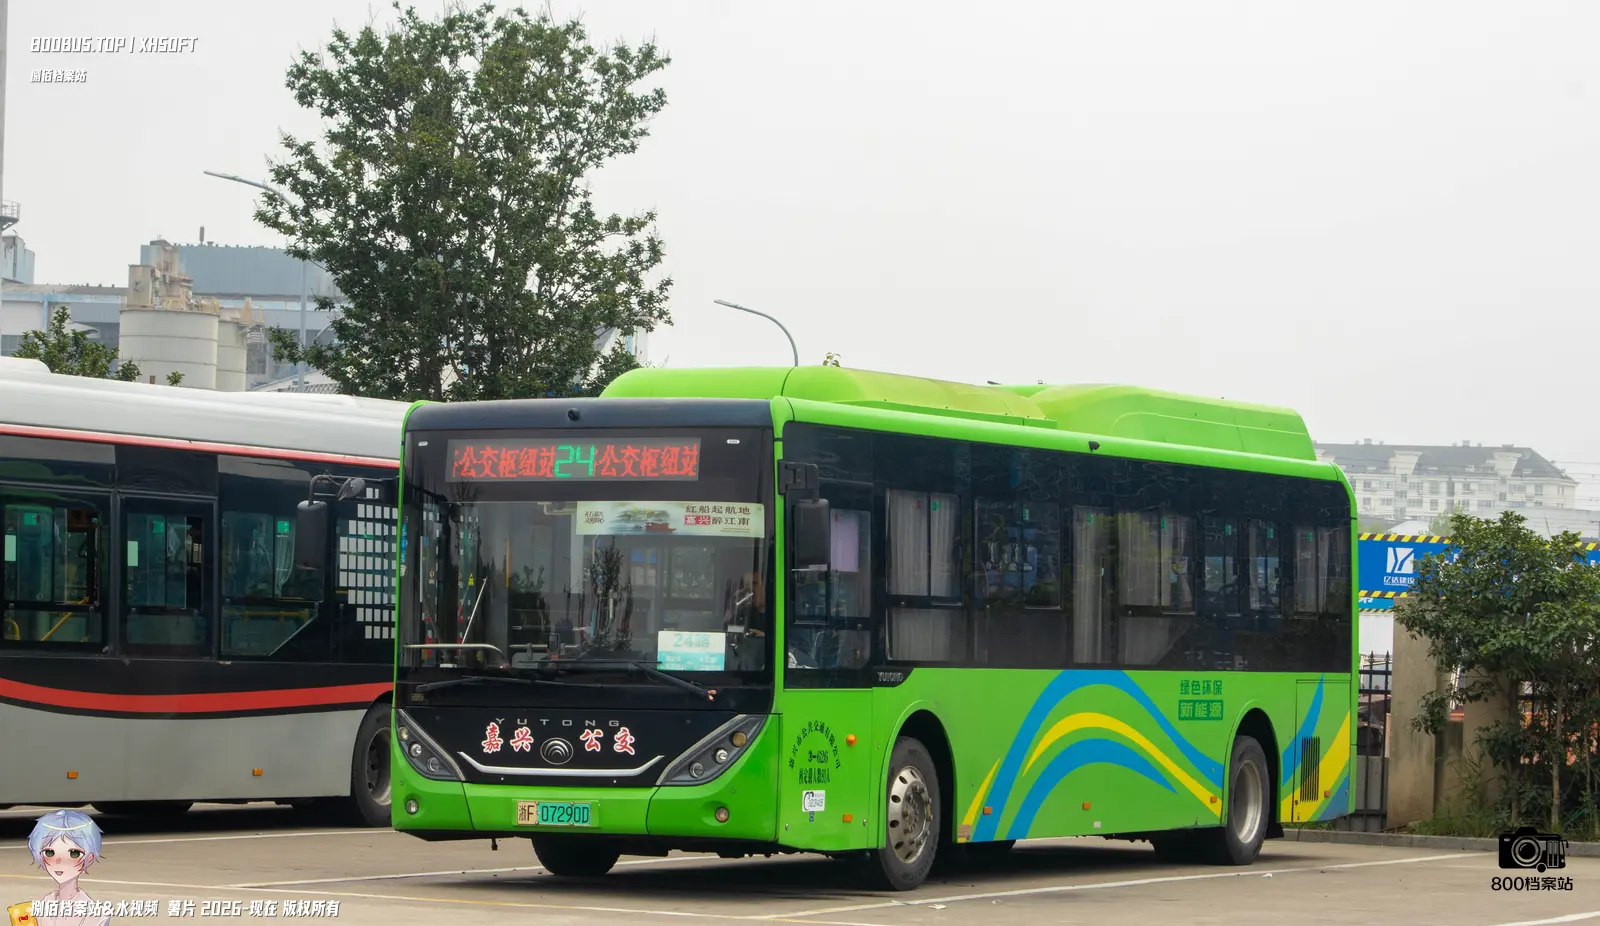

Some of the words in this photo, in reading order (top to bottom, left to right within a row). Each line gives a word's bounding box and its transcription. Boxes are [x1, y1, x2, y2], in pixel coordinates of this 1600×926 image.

[554, 445, 595, 477] 24
[685, 504, 751, 516] 红船起航地
[685, 515, 750, 526] 嘉兴醉江南
[1179, 679, 1223, 695] 绿色环保
[1180, 702, 1222, 718] 新能源
[496, 718, 619, 727] YUTONG
[481, 722, 534, 754] 嘉兴
[579, 727, 636, 756] 公交
[519, 804, 535, 822] 浙F
[541, 805, 589, 823] 07290D
